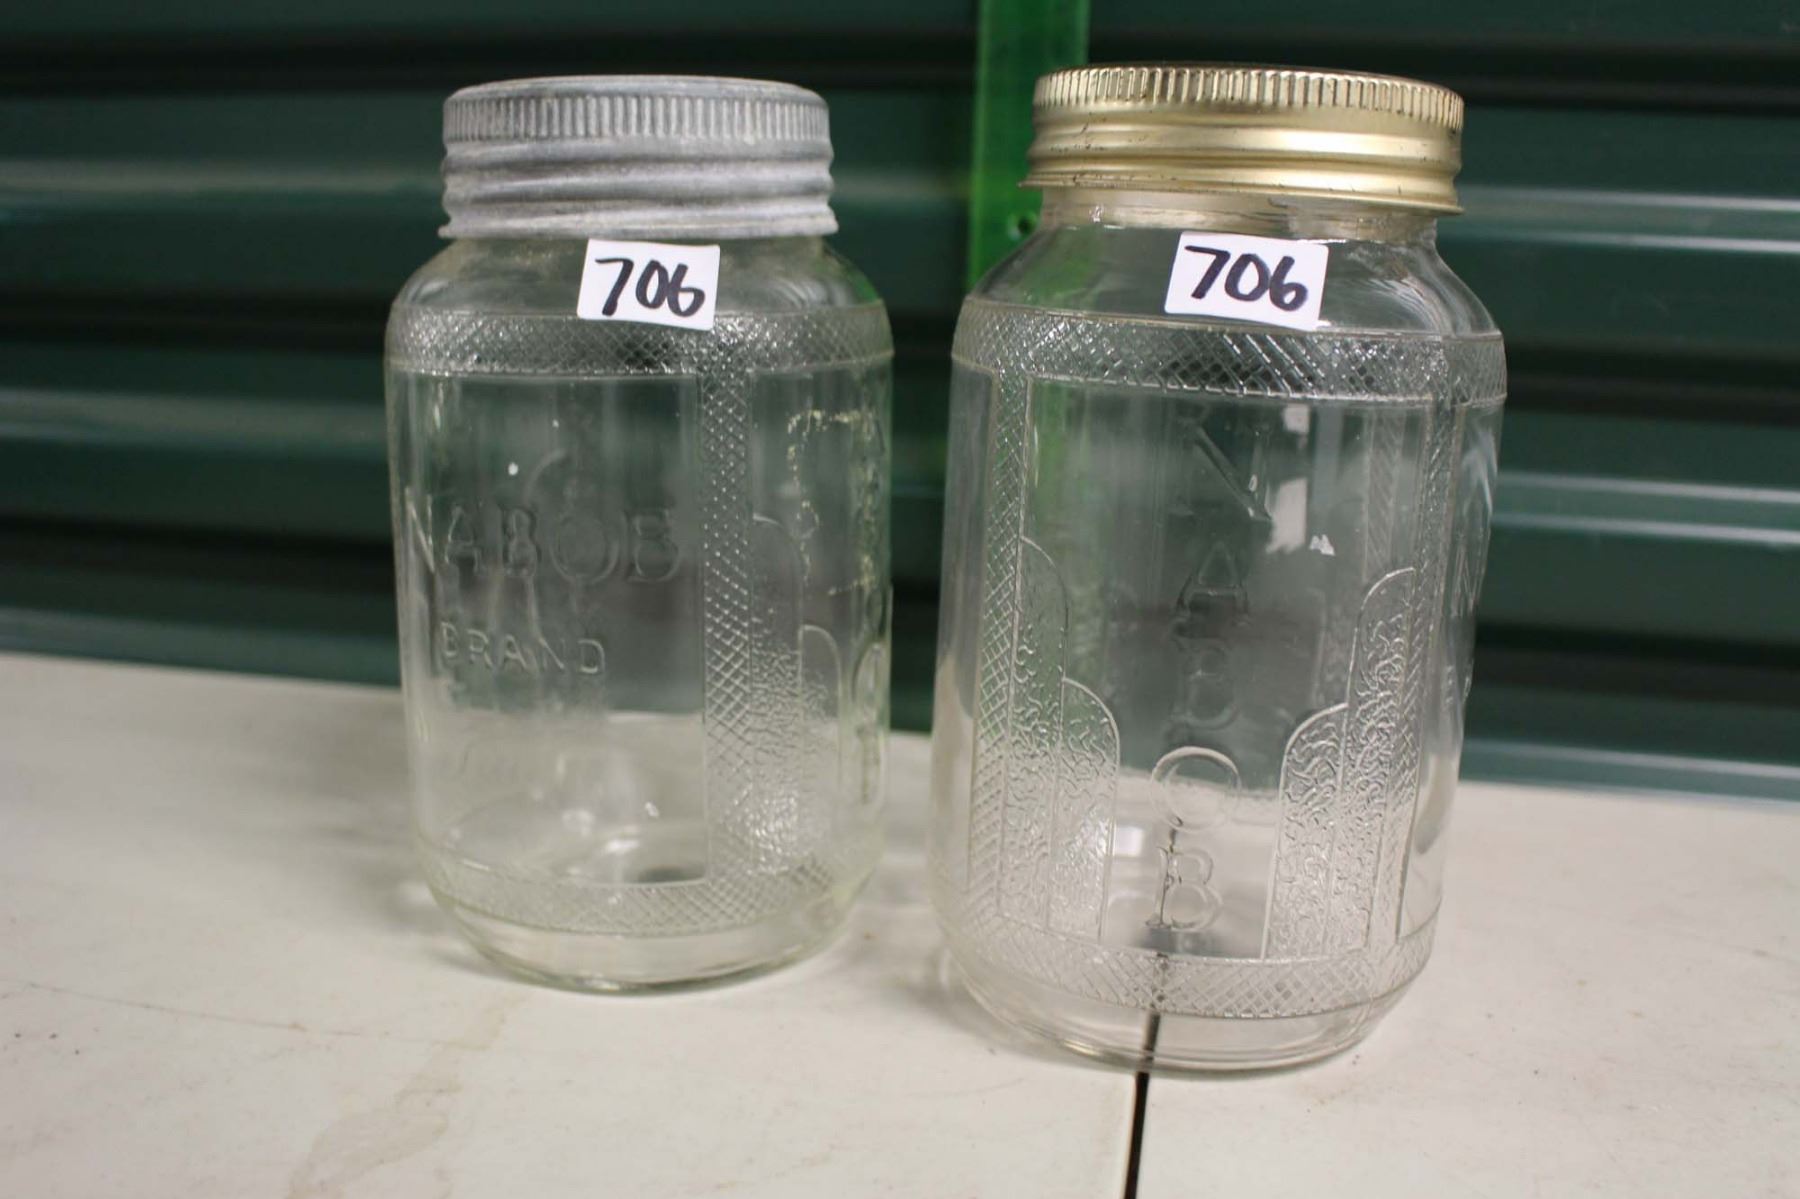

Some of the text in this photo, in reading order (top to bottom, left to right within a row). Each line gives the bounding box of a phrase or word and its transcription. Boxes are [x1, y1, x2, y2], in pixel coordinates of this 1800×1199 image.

[595, 257, 706, 317] 706
[1184, 245, 1309, 312] 706
[438, 619, 606, 678] BRAND
